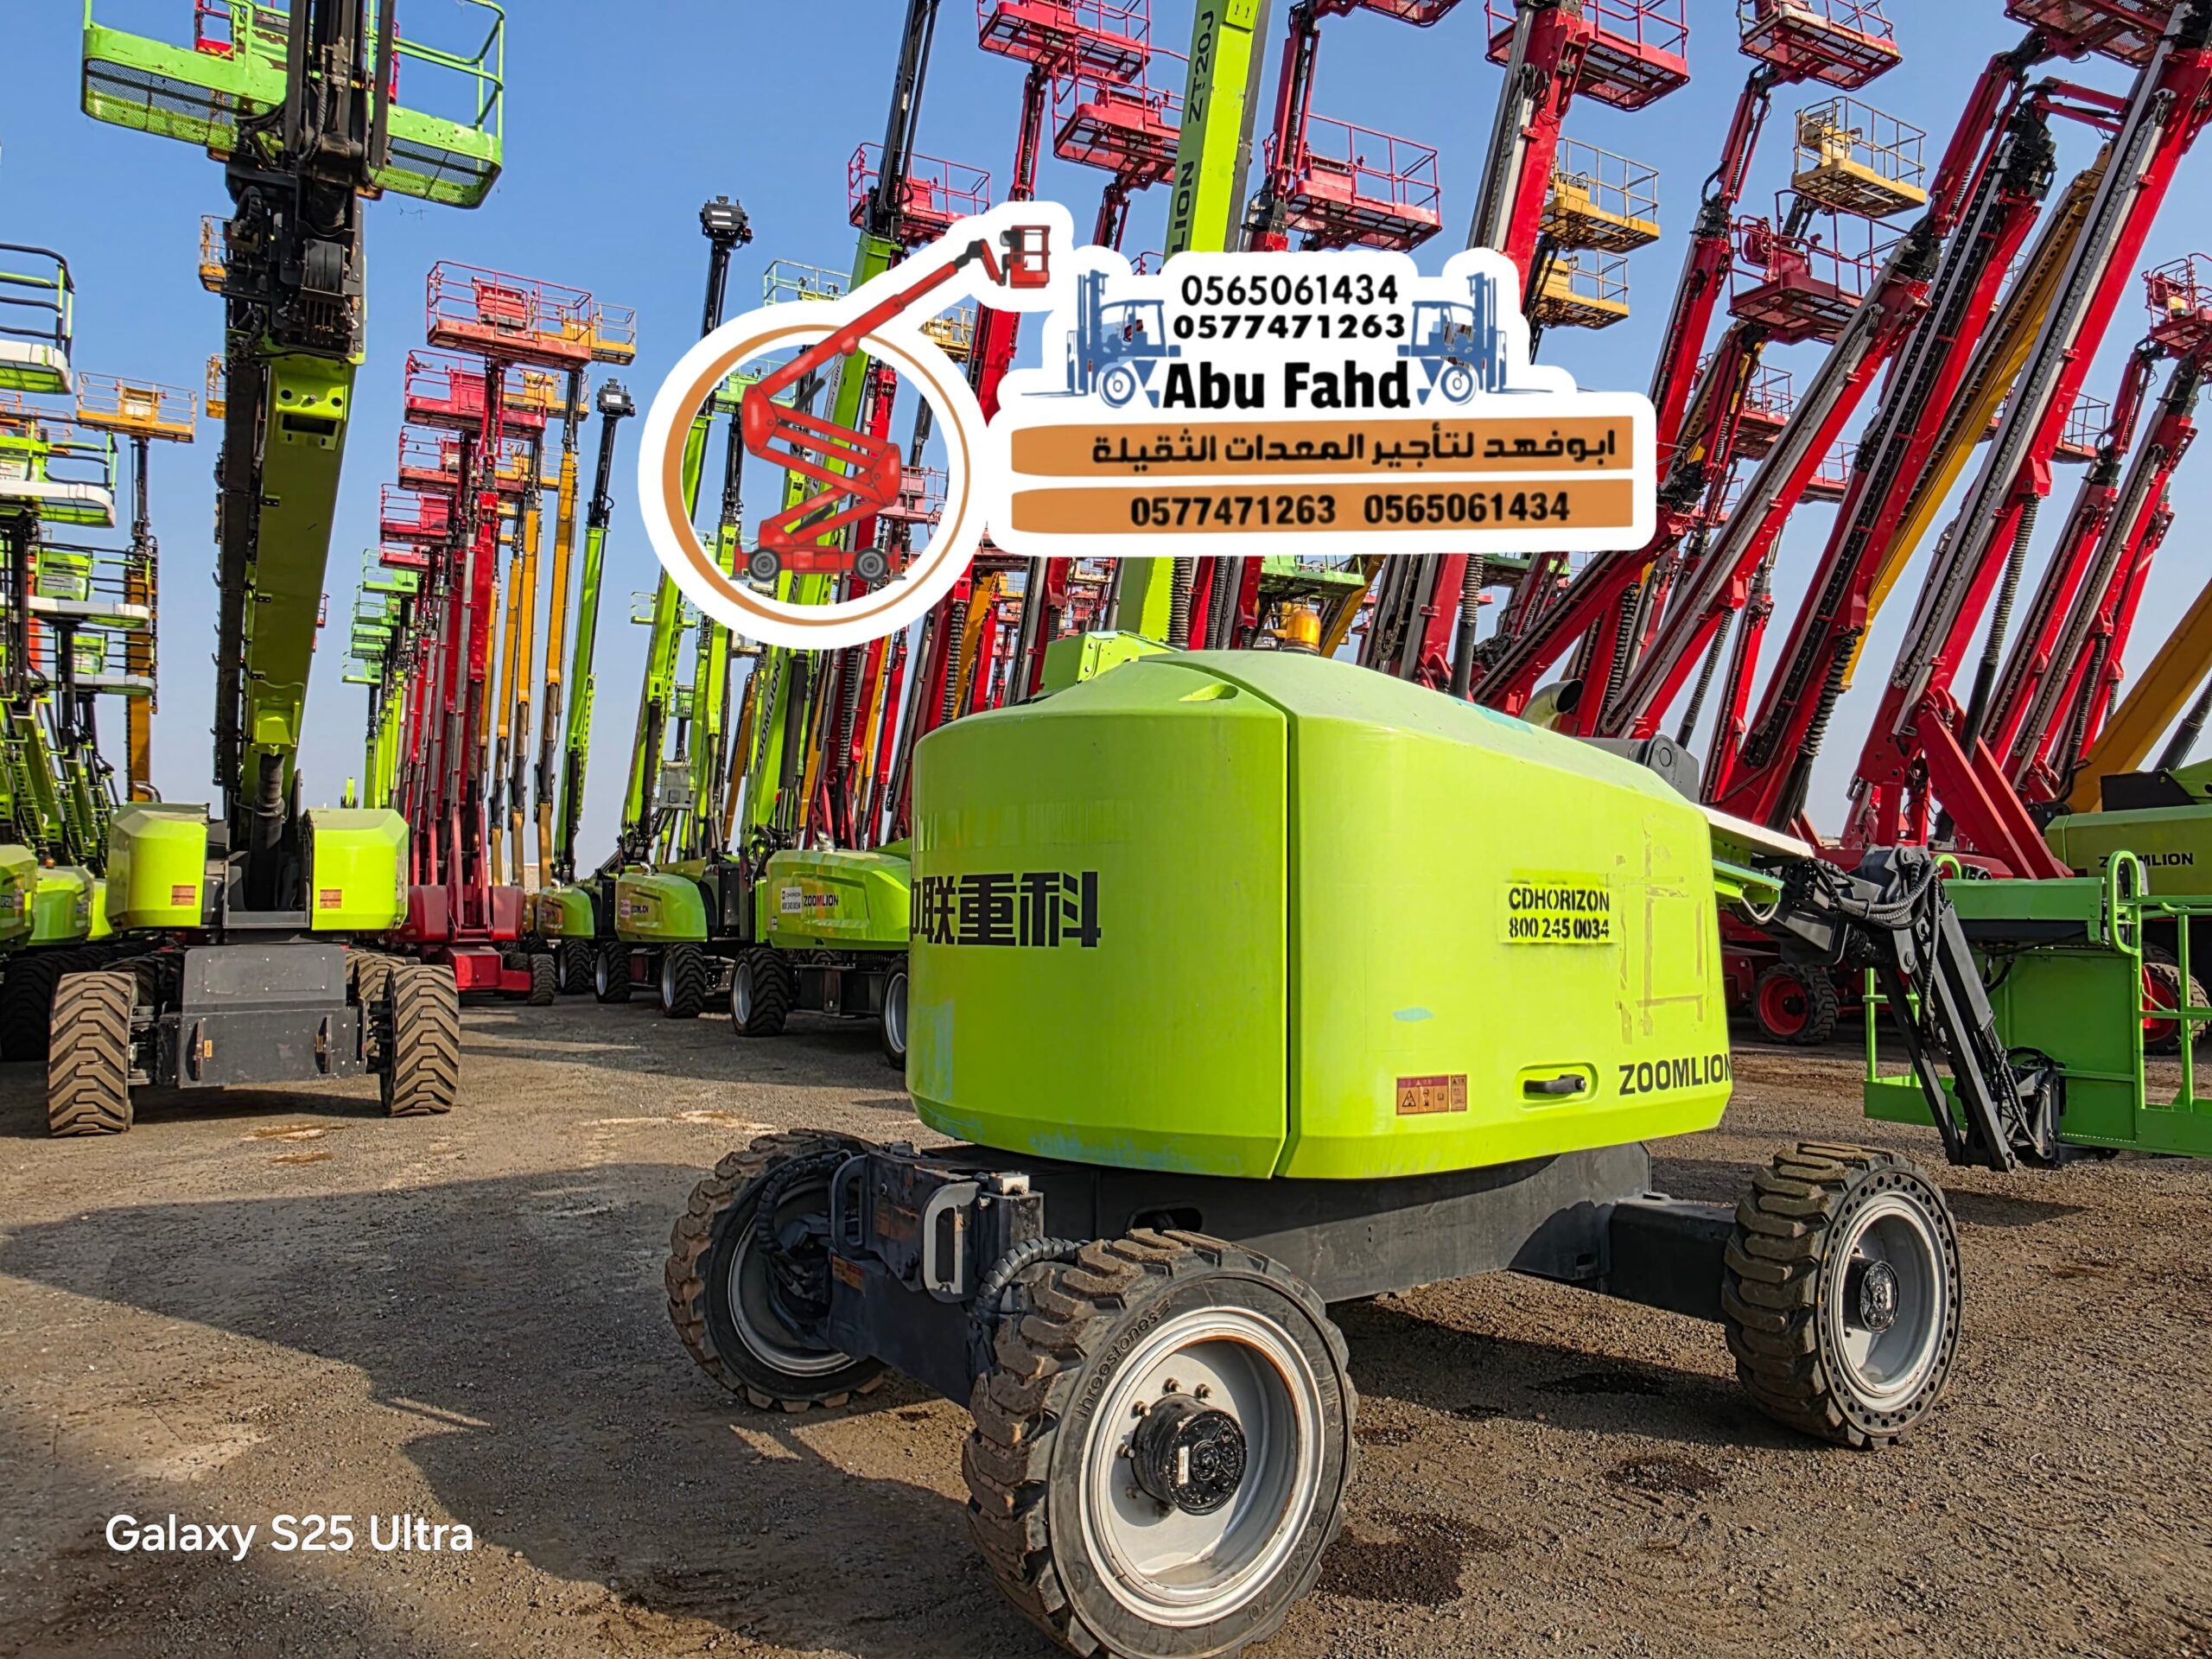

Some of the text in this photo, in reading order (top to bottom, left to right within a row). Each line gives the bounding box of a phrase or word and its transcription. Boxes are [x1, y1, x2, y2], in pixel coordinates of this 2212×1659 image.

[1188, 10, 1215, 124] ZT20J
[757, 661, 781, 774] ZOOMLION
[2098, 852, 2194, 868] ZMLION
[804, 893, 839, 906] ZOOMLION
[1509, 887, 1610, 912] CDHORIZON
[1509, 917, 1610, 940] 800 245 0034
